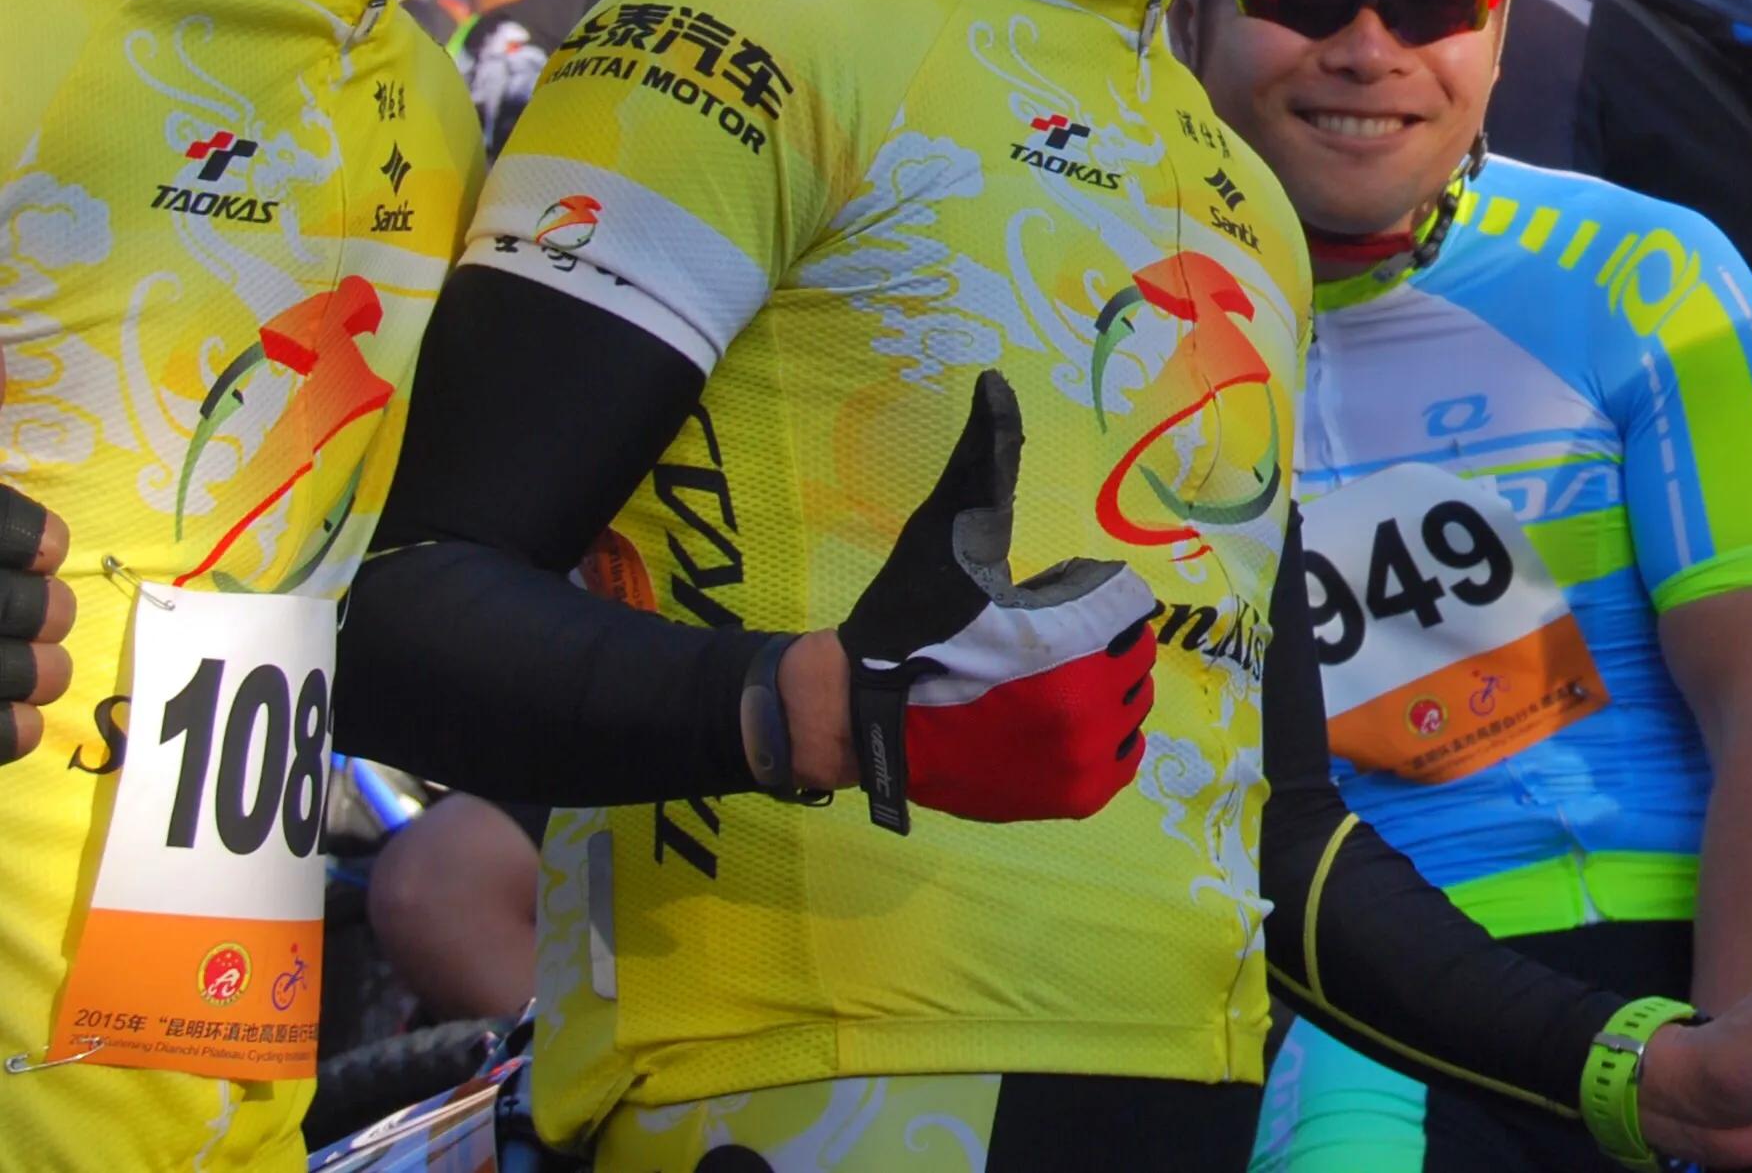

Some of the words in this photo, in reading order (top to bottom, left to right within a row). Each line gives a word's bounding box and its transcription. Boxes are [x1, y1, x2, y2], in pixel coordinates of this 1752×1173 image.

[641, 65, 767, 156] MOTOR
[1009, 143, 1122, 191] TAOKAS
[150, 183, 279, 225] TAOKAS
[370, 200, 415, 232] Santic
[1300, 500, 1514, 667] 949
[73, 1008, 148, 1033] 2015年
[201, 1045, 246, 1061] Plateau
